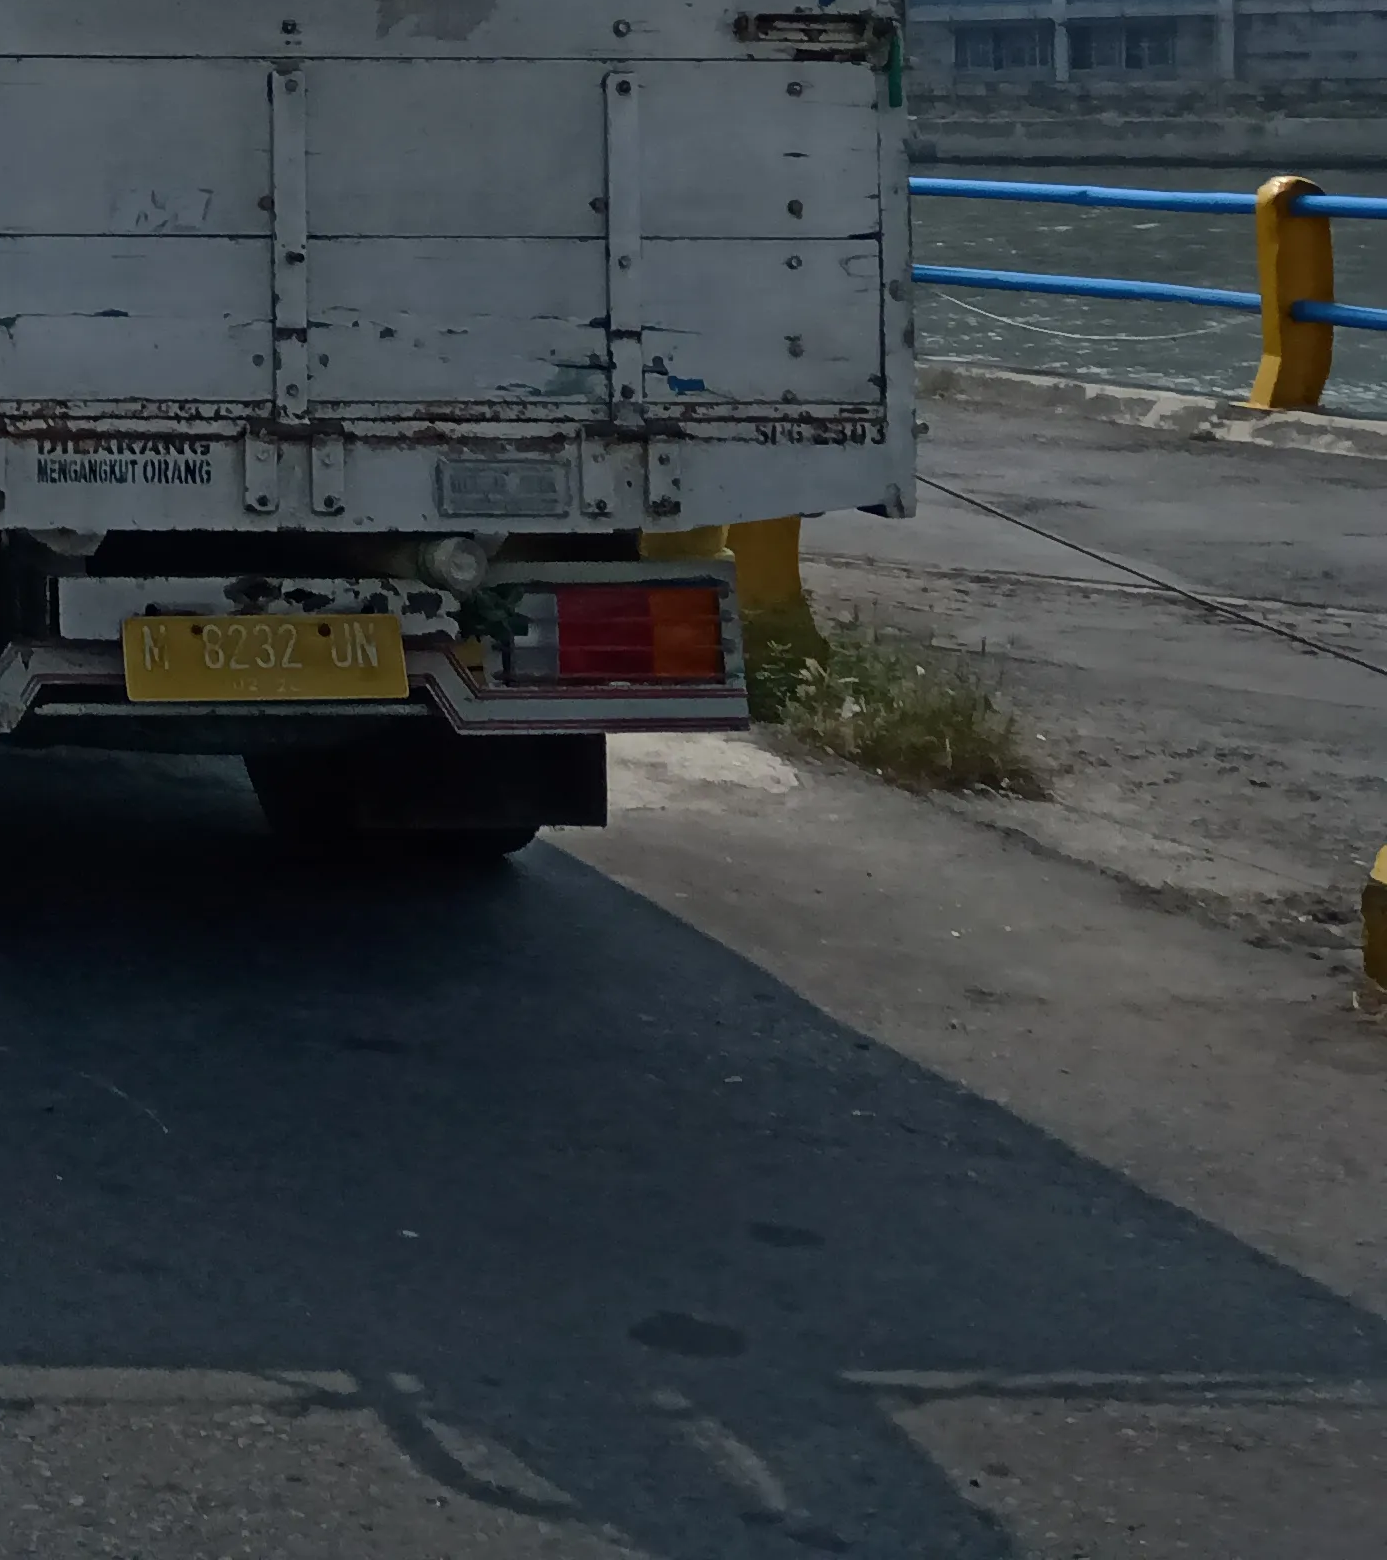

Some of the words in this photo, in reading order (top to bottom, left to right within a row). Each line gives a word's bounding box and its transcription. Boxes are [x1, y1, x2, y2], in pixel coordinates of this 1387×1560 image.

[36, 458, 139, 485] MENGANGKUT
[142, 458, 213, 485] ORANG
[201, 623, 303, 670] 8232
[330, 621, 379, 669] UN
